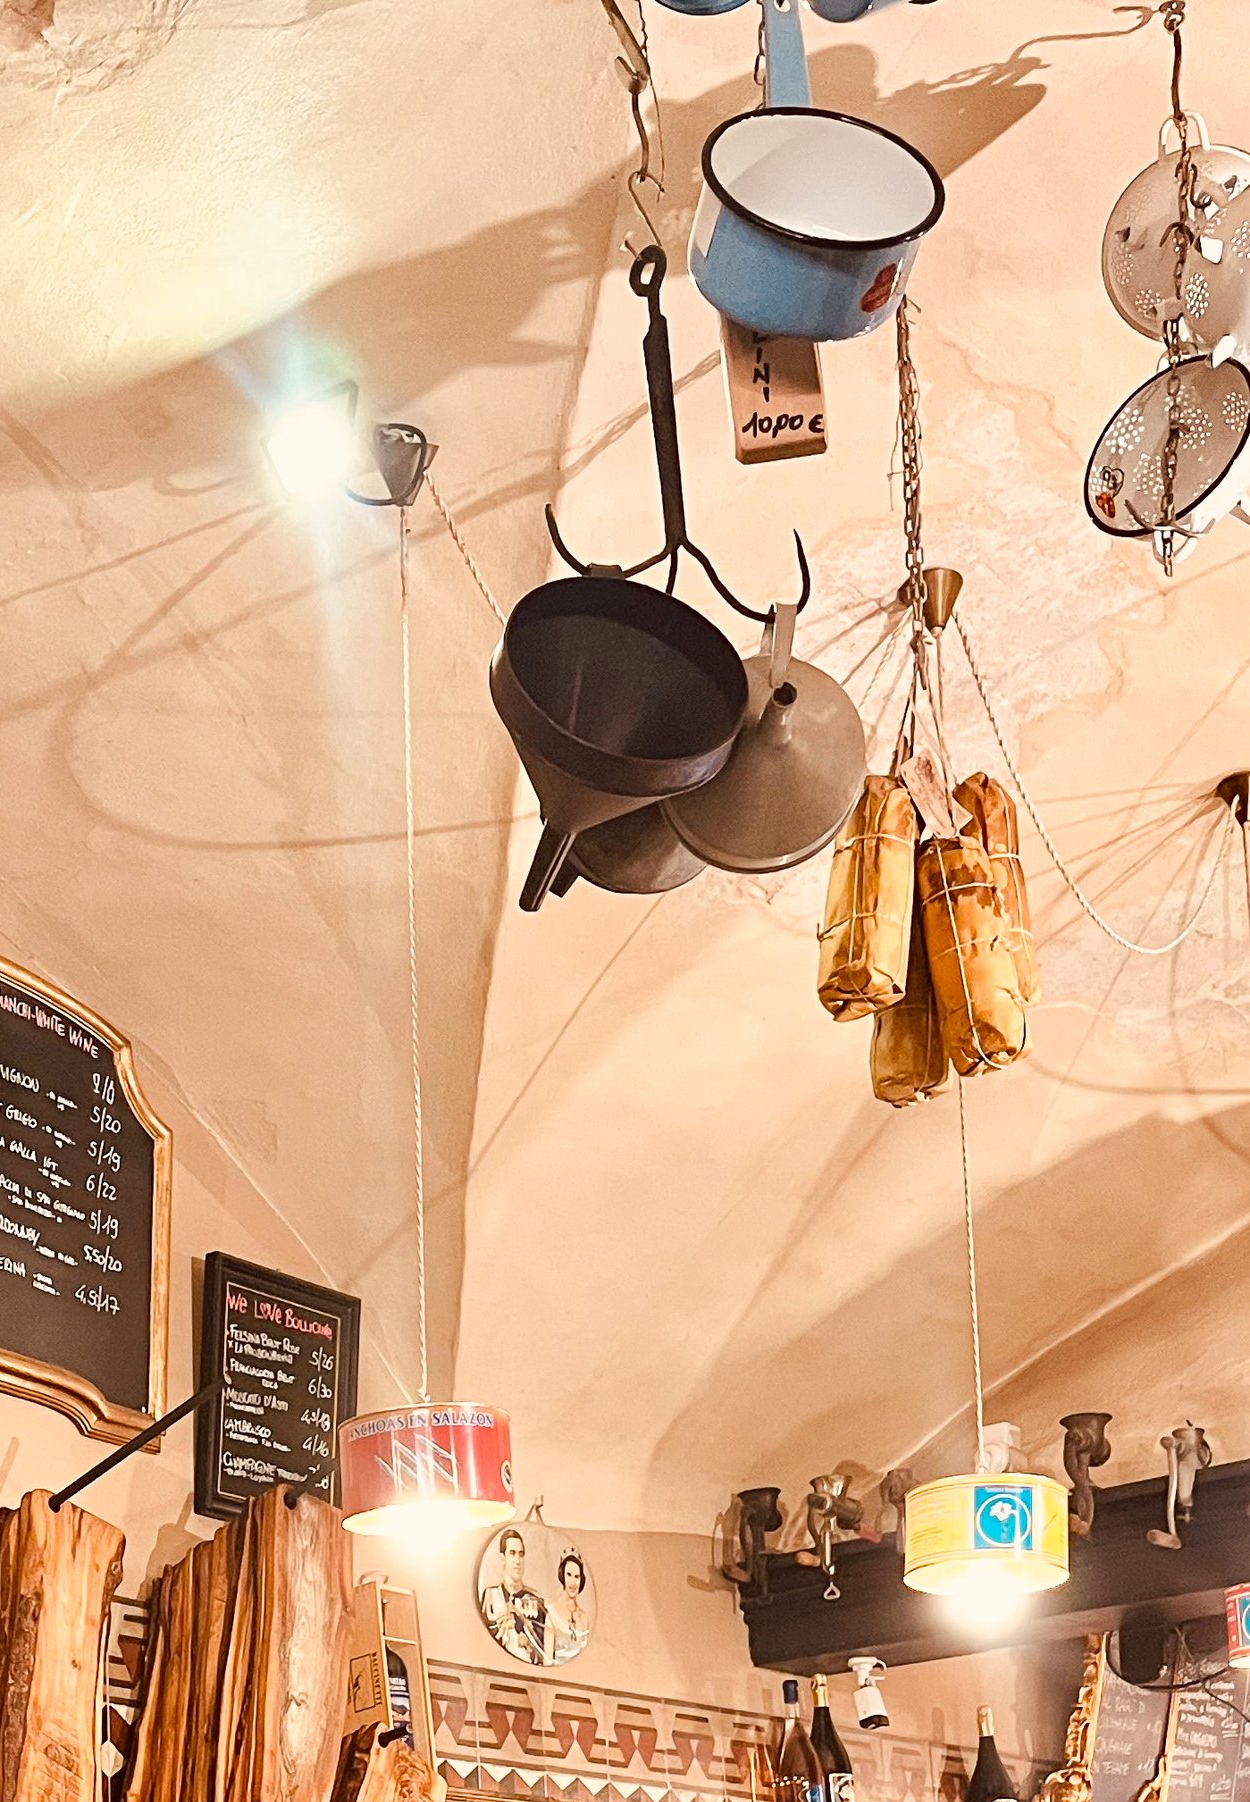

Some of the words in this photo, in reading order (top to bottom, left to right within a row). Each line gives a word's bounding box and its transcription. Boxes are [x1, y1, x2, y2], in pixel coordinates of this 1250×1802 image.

[68, 1024, 100, 1059] WINE
[89, 1106, 122, 1134] 5/20
[87, 1140, 122, 1173] 5/19
[85, 1172, 118, 1201] 6/22
[88, 1209, 120, 1240] 5/19
[308, 1346, 334, 1372] 5/26
[307, 1375, 333, 1399] 6/30
[408, 1412, 427, 1428] EN
[432, 1411, 494, 1428] SALAZON
